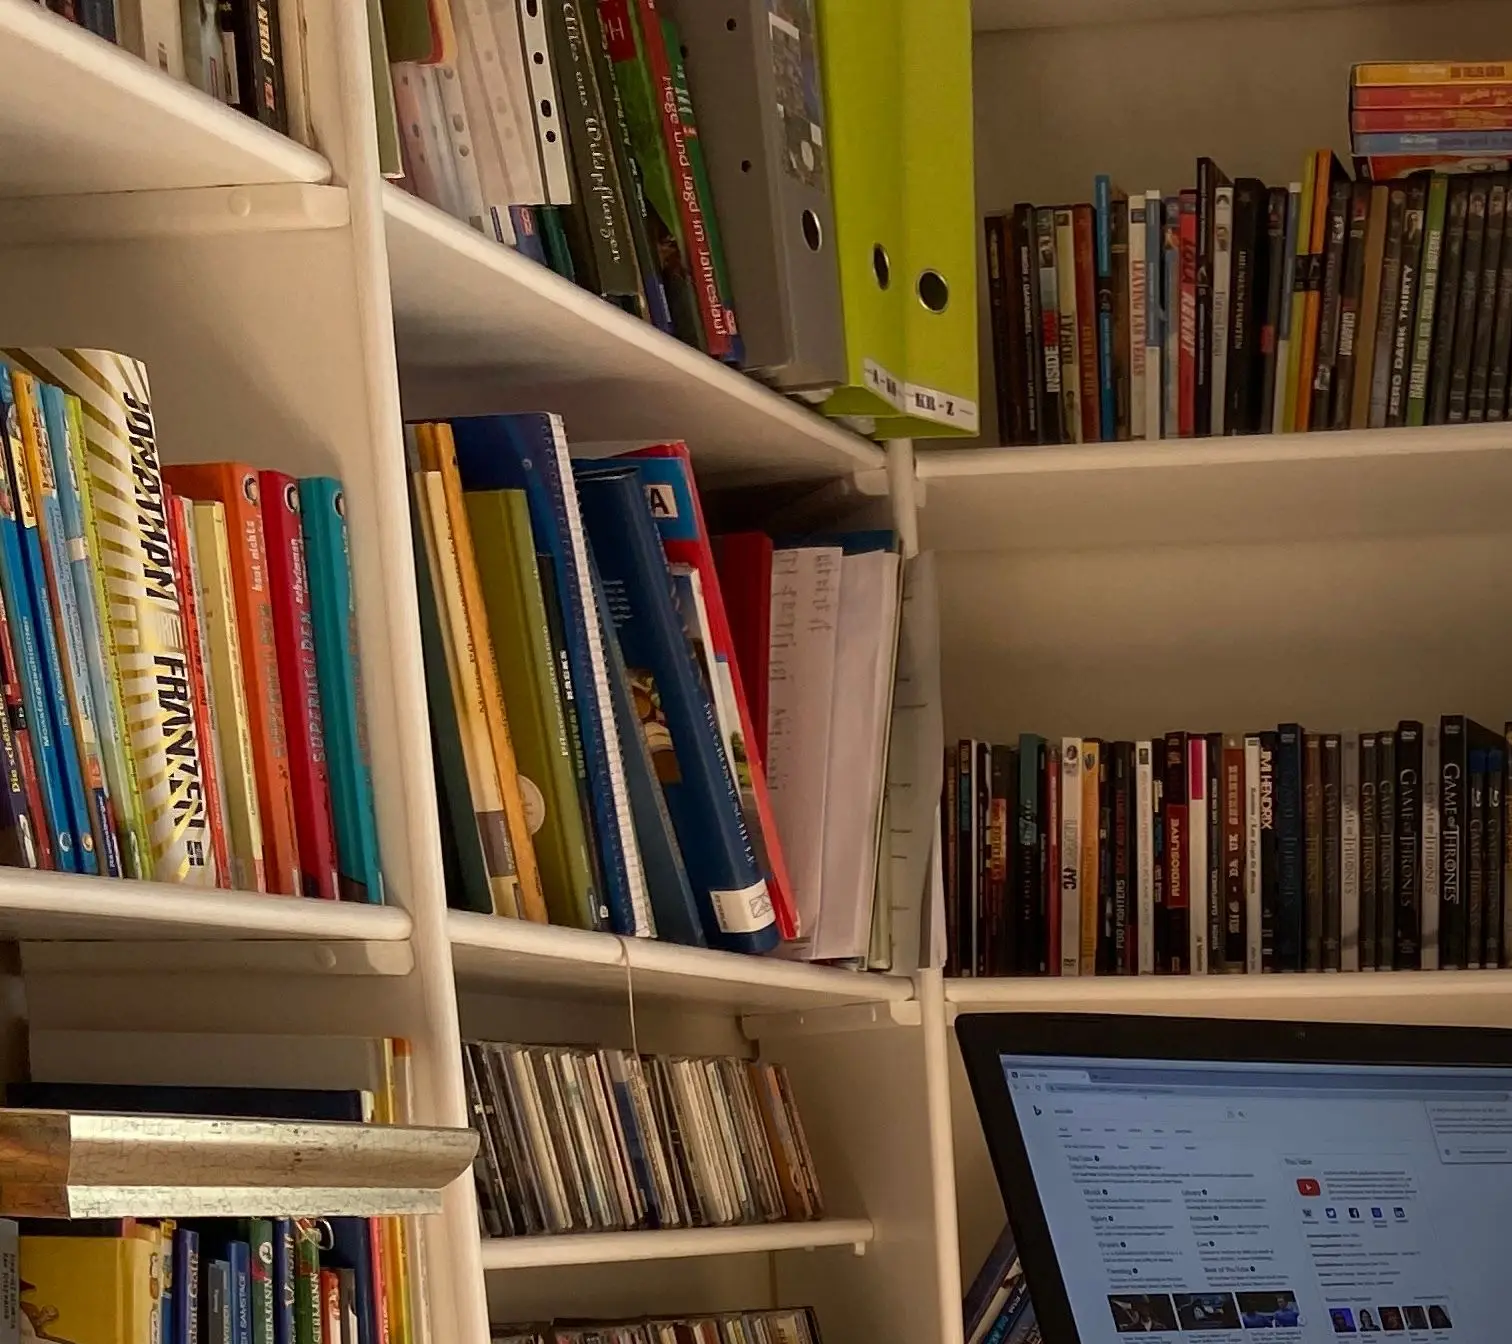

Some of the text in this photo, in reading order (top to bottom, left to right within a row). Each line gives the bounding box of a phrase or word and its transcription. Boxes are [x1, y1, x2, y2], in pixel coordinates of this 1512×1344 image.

[662, 77, 728, 336] Hege und Jagd im Jahreslauf
[1132, 260, 1145, 376] LEAVING LAS VEGAS
[648, 487, 673, 516] A
[123, 391, 206, 830] JONATHAN FRANZEN
[1260, 748, 1272, 829] JIMI HENDRIX
[1400, 768, 1417, 907] GAME THRONES
[1443, 763, 1460, 904] GAME THRONES
[1171, 819, 1180, 897] AUDIOSLAVE
[237, 1271, 248, 1328] SAMSTAGE
